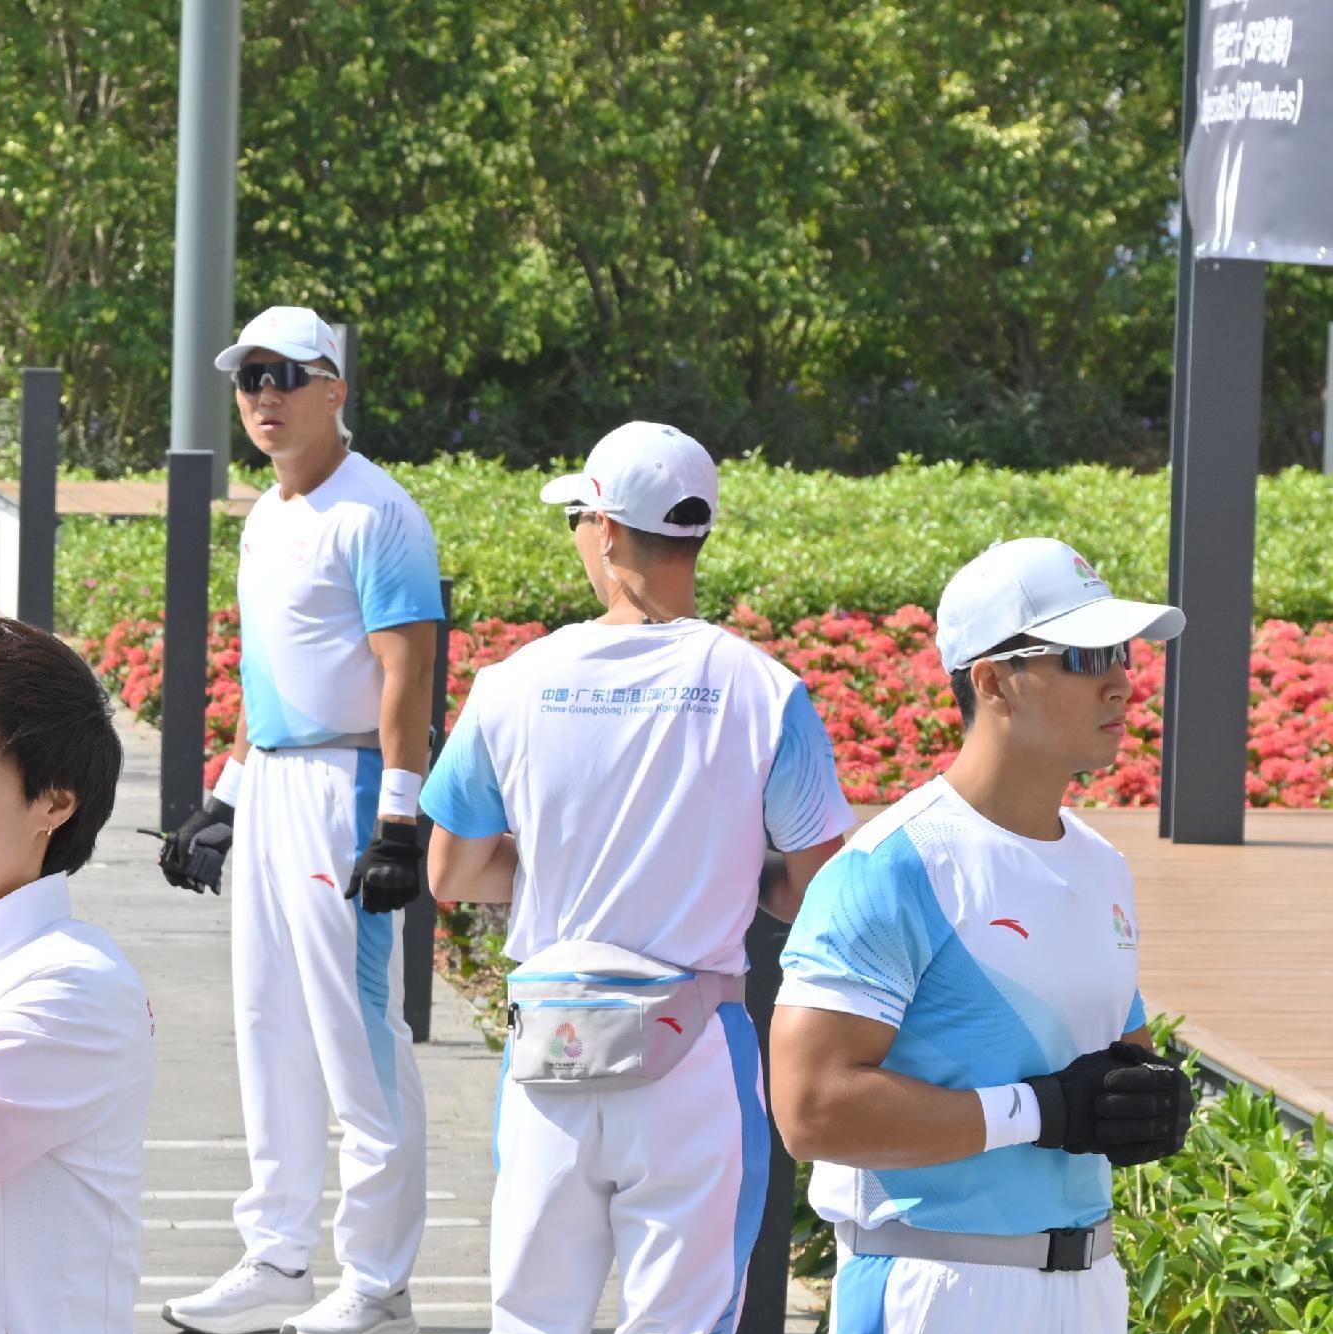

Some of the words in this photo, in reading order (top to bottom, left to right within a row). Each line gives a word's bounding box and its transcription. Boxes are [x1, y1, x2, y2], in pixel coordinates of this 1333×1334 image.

[680, 687, 721, 703] 2025
[655, 702, 680, 714] Kong
[686, 703, 719, 716] Macao
